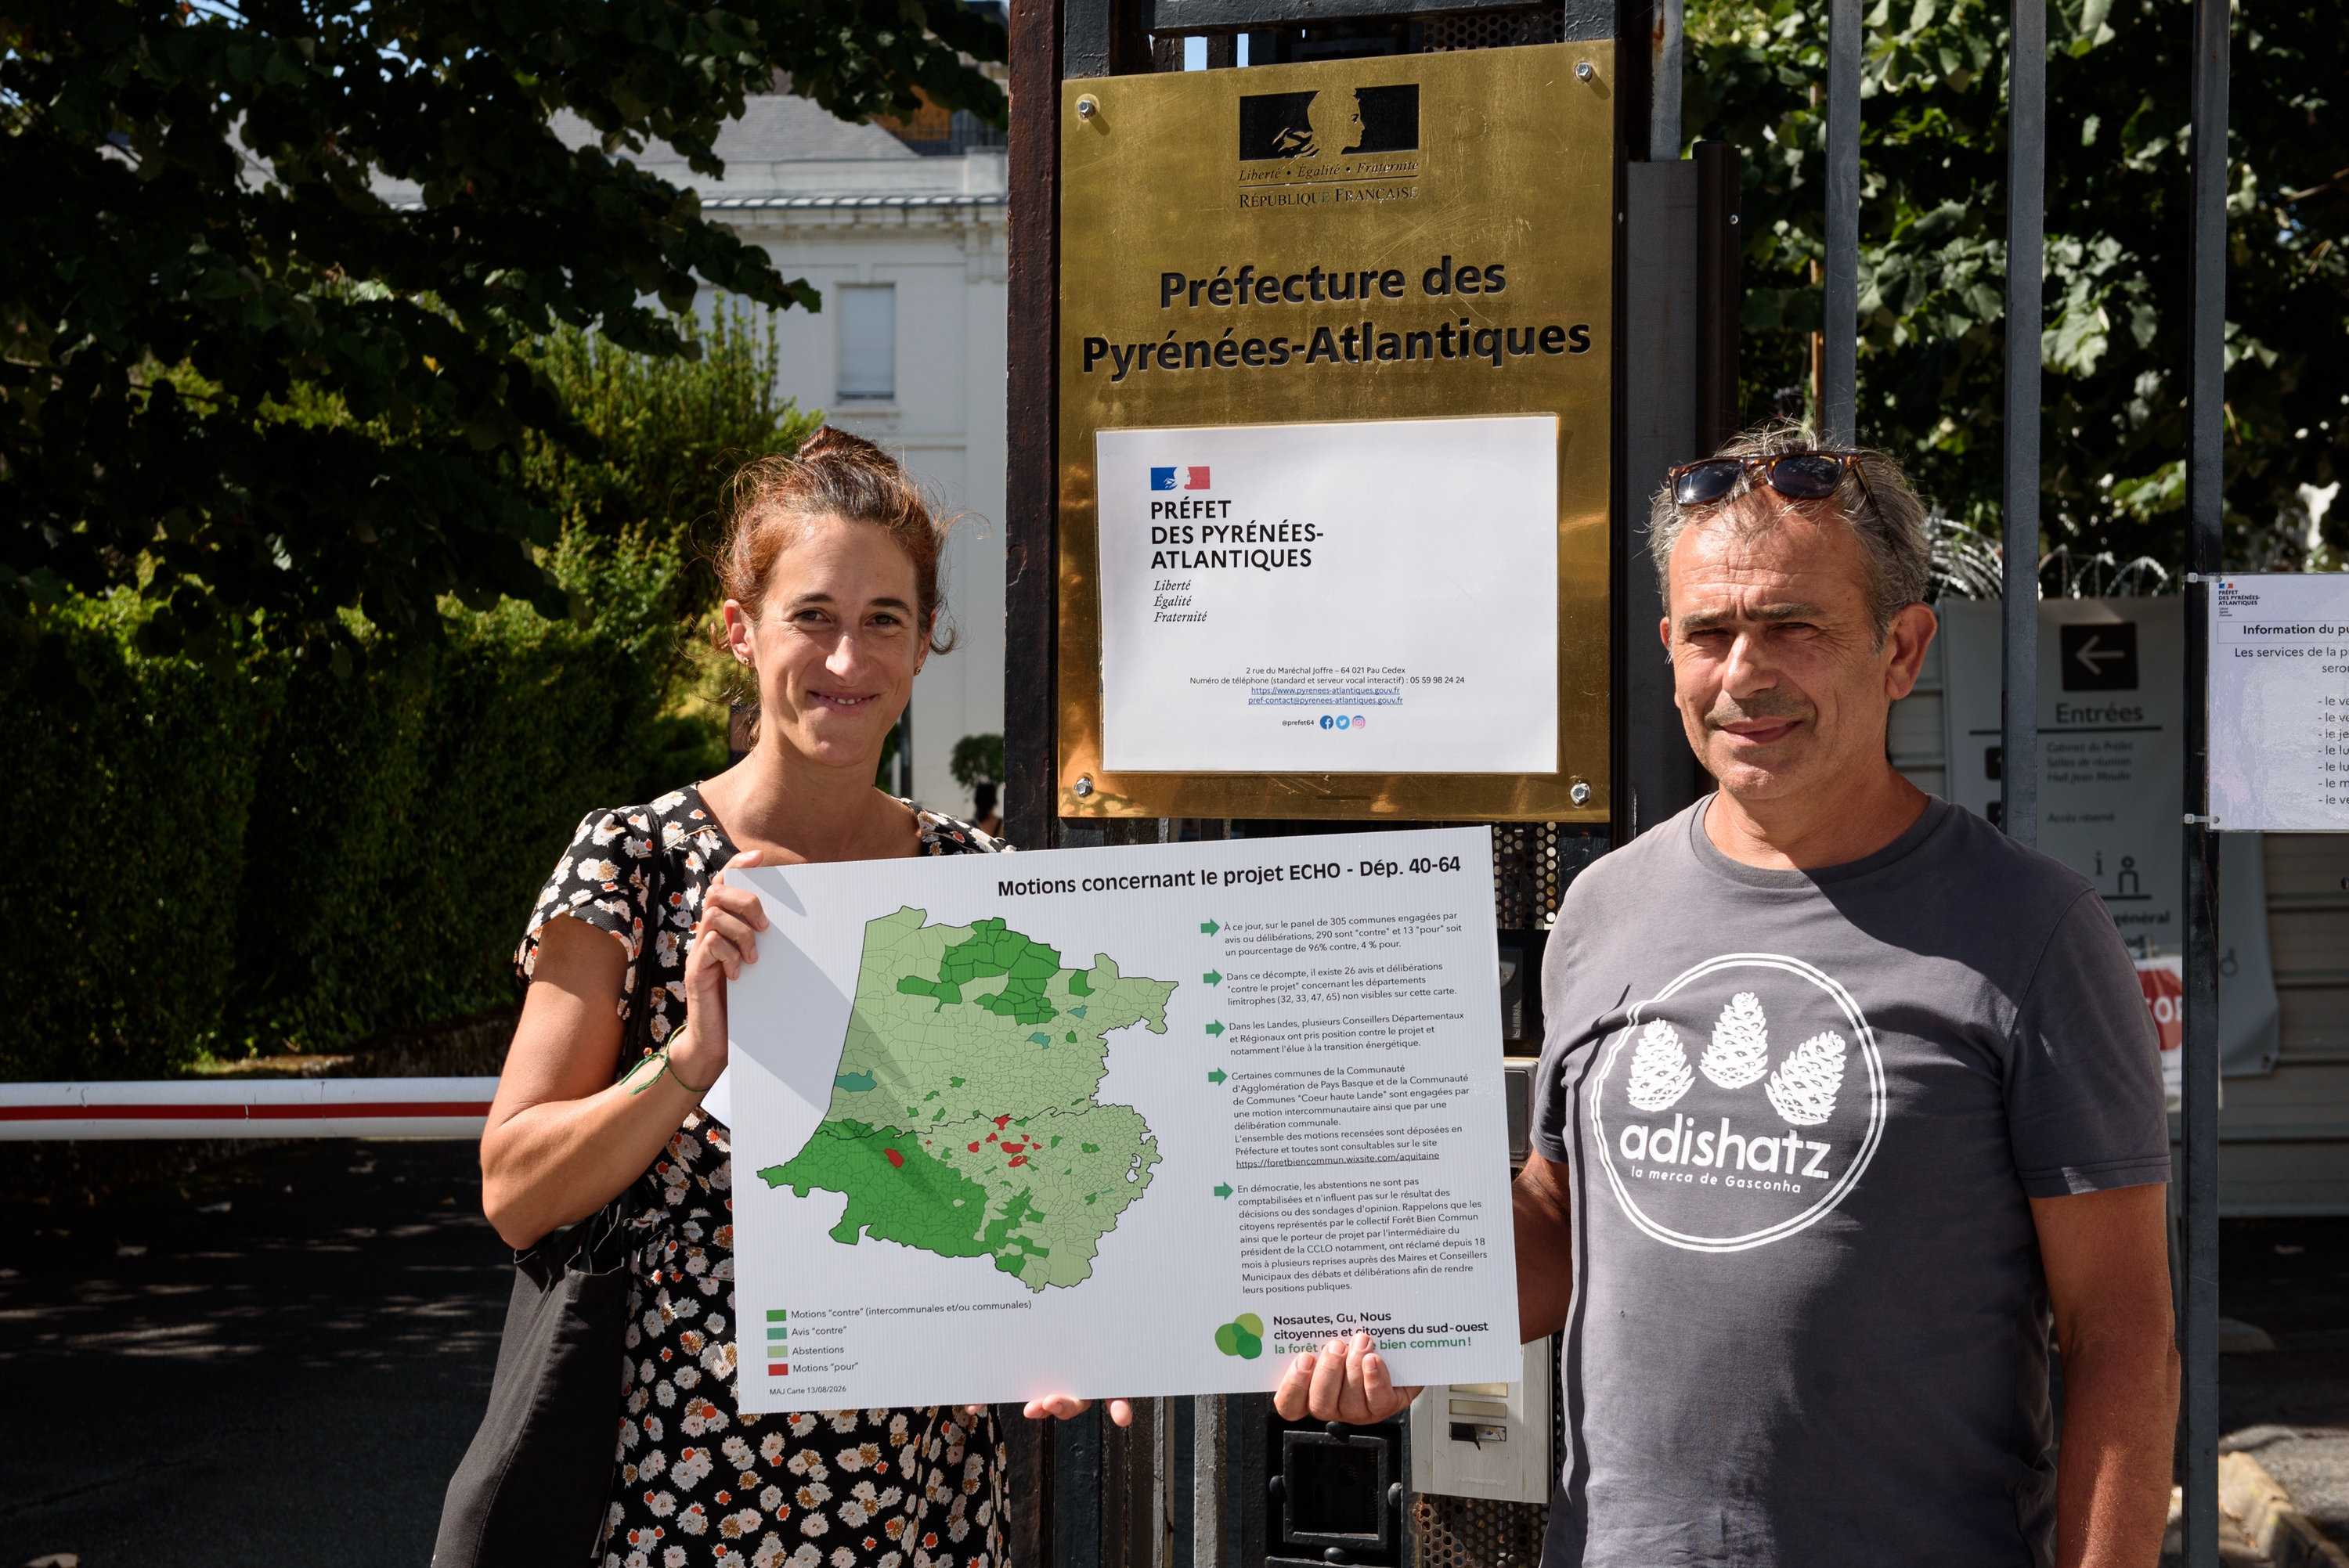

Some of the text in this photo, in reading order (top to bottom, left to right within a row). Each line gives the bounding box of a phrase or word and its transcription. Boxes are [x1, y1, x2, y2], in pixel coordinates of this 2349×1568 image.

[1238, 160, 1418, 182] Liberté Égalité Fraternité
[1160, 255, 1506, 309] Préfecture des
[1083, 316, 1591, 382] Pyrénées-Atlantiques
[1151, 496, 1232, 520] PRÉFET
[1151, 518, 1324, 545] DES PYRÉNÉES-
[1150, 548, 1312, 572] ATLANTIQUES
[1153, 579, 1192, 591] Liberté
[1153, 593, 1193, 610] Égalité
[1153, 611, 1208, 622] Fraternité
[2243, 625, 2315, 634] Information
[2318, 624, 2334, 633] du
[2235, 648, 2253, 657] Les
[2257, 647, 2304, 657] services
[2308, 647, 2322, 657] de
[2326, 647, 2336, 656] la
[1265, 666, 1276, 675] du
[1277, 666, 1312, 675] Maréchal
[1312, 666, 1333, 676] Joffre
[1232, 676, 1269, 686] téléphone
[1270, 676, 1306, 686] (standard
[1366, 676, 1405, 686] interactif)
[1421, 676, 1431, 684] 59
[1432, 676, 1443, 684] 98
[1444, 676, 1454, 684] 24
[1455, 676, 1465, 684] 24
[1250, 686, 1401, 696] https://www.pyrenees-atlantiques.gouv.fr
[1247, 696, 1404, 706] pref-contact@pyrenees-atlantiques.gouv.fr
[2325, 696, 2336, 705] le
[2056, 703, 2144, 723] Entrées
[2325, 712, 2336, 722] le
[1282, 719, 1315, 727] @prefet64
[2325, 729, 2336, 738] le
[2325, 745, 2336, 755] le
[2325, 762, 2336, 771] le
[2325, 778, 2336, 788] le
[2325, 795, 2336, 804] le
[998, 878, 1077, 897] Motions
[1081, 870, 1196, 892] concernant
[1200, 869, 1218, 885] le
[1223, 865, 1284, 887] projet
[1289, 862, 1340, 881] ECHO
[1359, 859, 1404, 878] Dép.
[1409, 856, 1461, 874] 40-64
[1223, 921, 1232, 932] À
[1244, 922, 1264, 933] jour,
[1280, 920, 1289, 928] le
[1290, 918, 1315, 930] panel
[1316, 917, 1329, 927] de
[1330, 917, 1347, 926] 305
[1348, 916, 1396, 925] communes
[1398, 912, 1442, 924] engagées
[1442, 913, 1458, 922] par
[1225, 935, 1241, 944] avis
[1256, 932, 1315, 943] délibérations,
[1315, 930, 1333, 939] 290
[1334, 930, 1354, 939] sont
[1403, 925, 1414, 935] 13
[1445, 924, 1462, 932] soit
[1238, 946, 1294, 958] pourcentage
[1294, 944, 1307, 953] de
[1308, 943, 1328, 952] 96%
[1329, 943, 1359, 951] contre,
[1360, 941, 1367, 950] 4
[1368, 940, 1377, 949] %
[1379, 941, 1402, 950] pour.
[1620, 1113, 1831, 1179] adishatz
[1236, 1152, 1441, 1170] https://foretbiencommun.wixsite.com/aquitaine
[1631, 1165, 1801, 1194] la merca de Gasconha
[791, 1310, 827, 1319] Motions
[865, 1303, 945, 1317] (intercommunales
[946, 1303, 970, 1312] et/ou
[972, 1299, 1032, 1311] communales)
[1273, 1312, 1391, 1326] Nosautes, Gu, Nous
[791, 1327, 810, 1336] Avis
[1274, 1330, 1338, 1341] citoyennes
[1340, 1328, 1353, 1337] et
[1408, 1325, 1423, 1334] du
[1426, 1322, 1488, 1333] sud-ouest
[792, 1346, 845, 1356] Abstentions
[1275, 1344, 1285, 1354] la
[1288, 1343, 1318, 1354] forêt
[1380, 1339, 1406, 1350] bien
[792, 1364, 828, 1373] Motions
